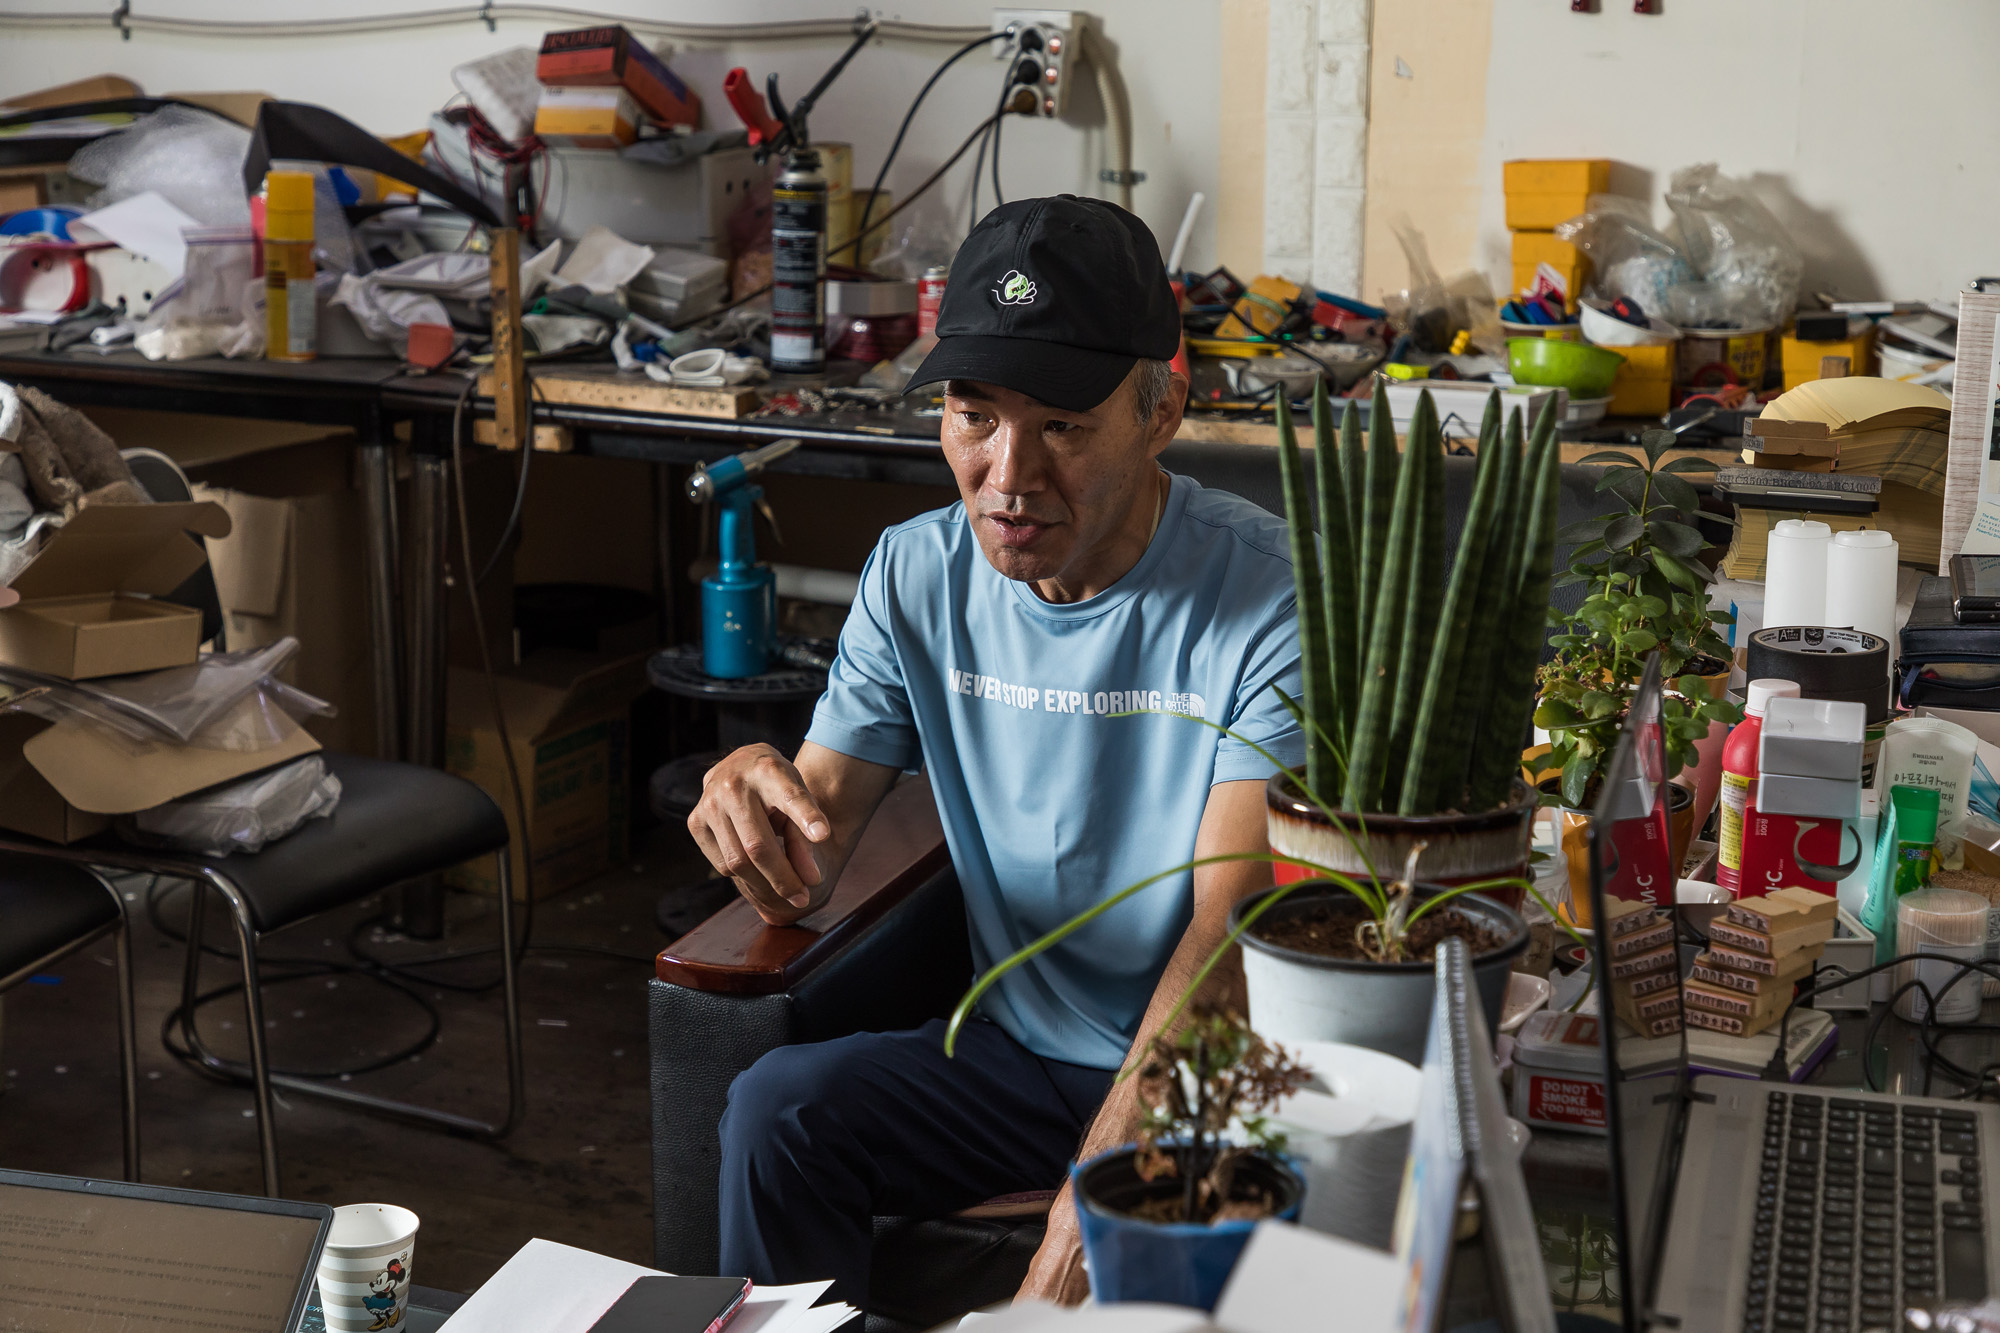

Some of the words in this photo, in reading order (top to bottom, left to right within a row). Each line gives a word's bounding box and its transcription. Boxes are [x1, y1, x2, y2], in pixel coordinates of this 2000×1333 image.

[949, 668, 1002, 702] NEVER
[1002, 684, 1039, 710] STOP
[1045, 690, 1162, 715] EXPLORING
[1171, 692, 1189, 701] THE
[1894, 773, 1957, 789] 아프리카에서
[1542, 1080, 1560, 1092] DO
[1562, 1084, 1590, 1096] NOT
[1541, 1092, 1589, 1107] SMOKE
[1540, 1103, 1564, 1114] TOO
[1566, 1106, 1603, 1119] MUCH!
